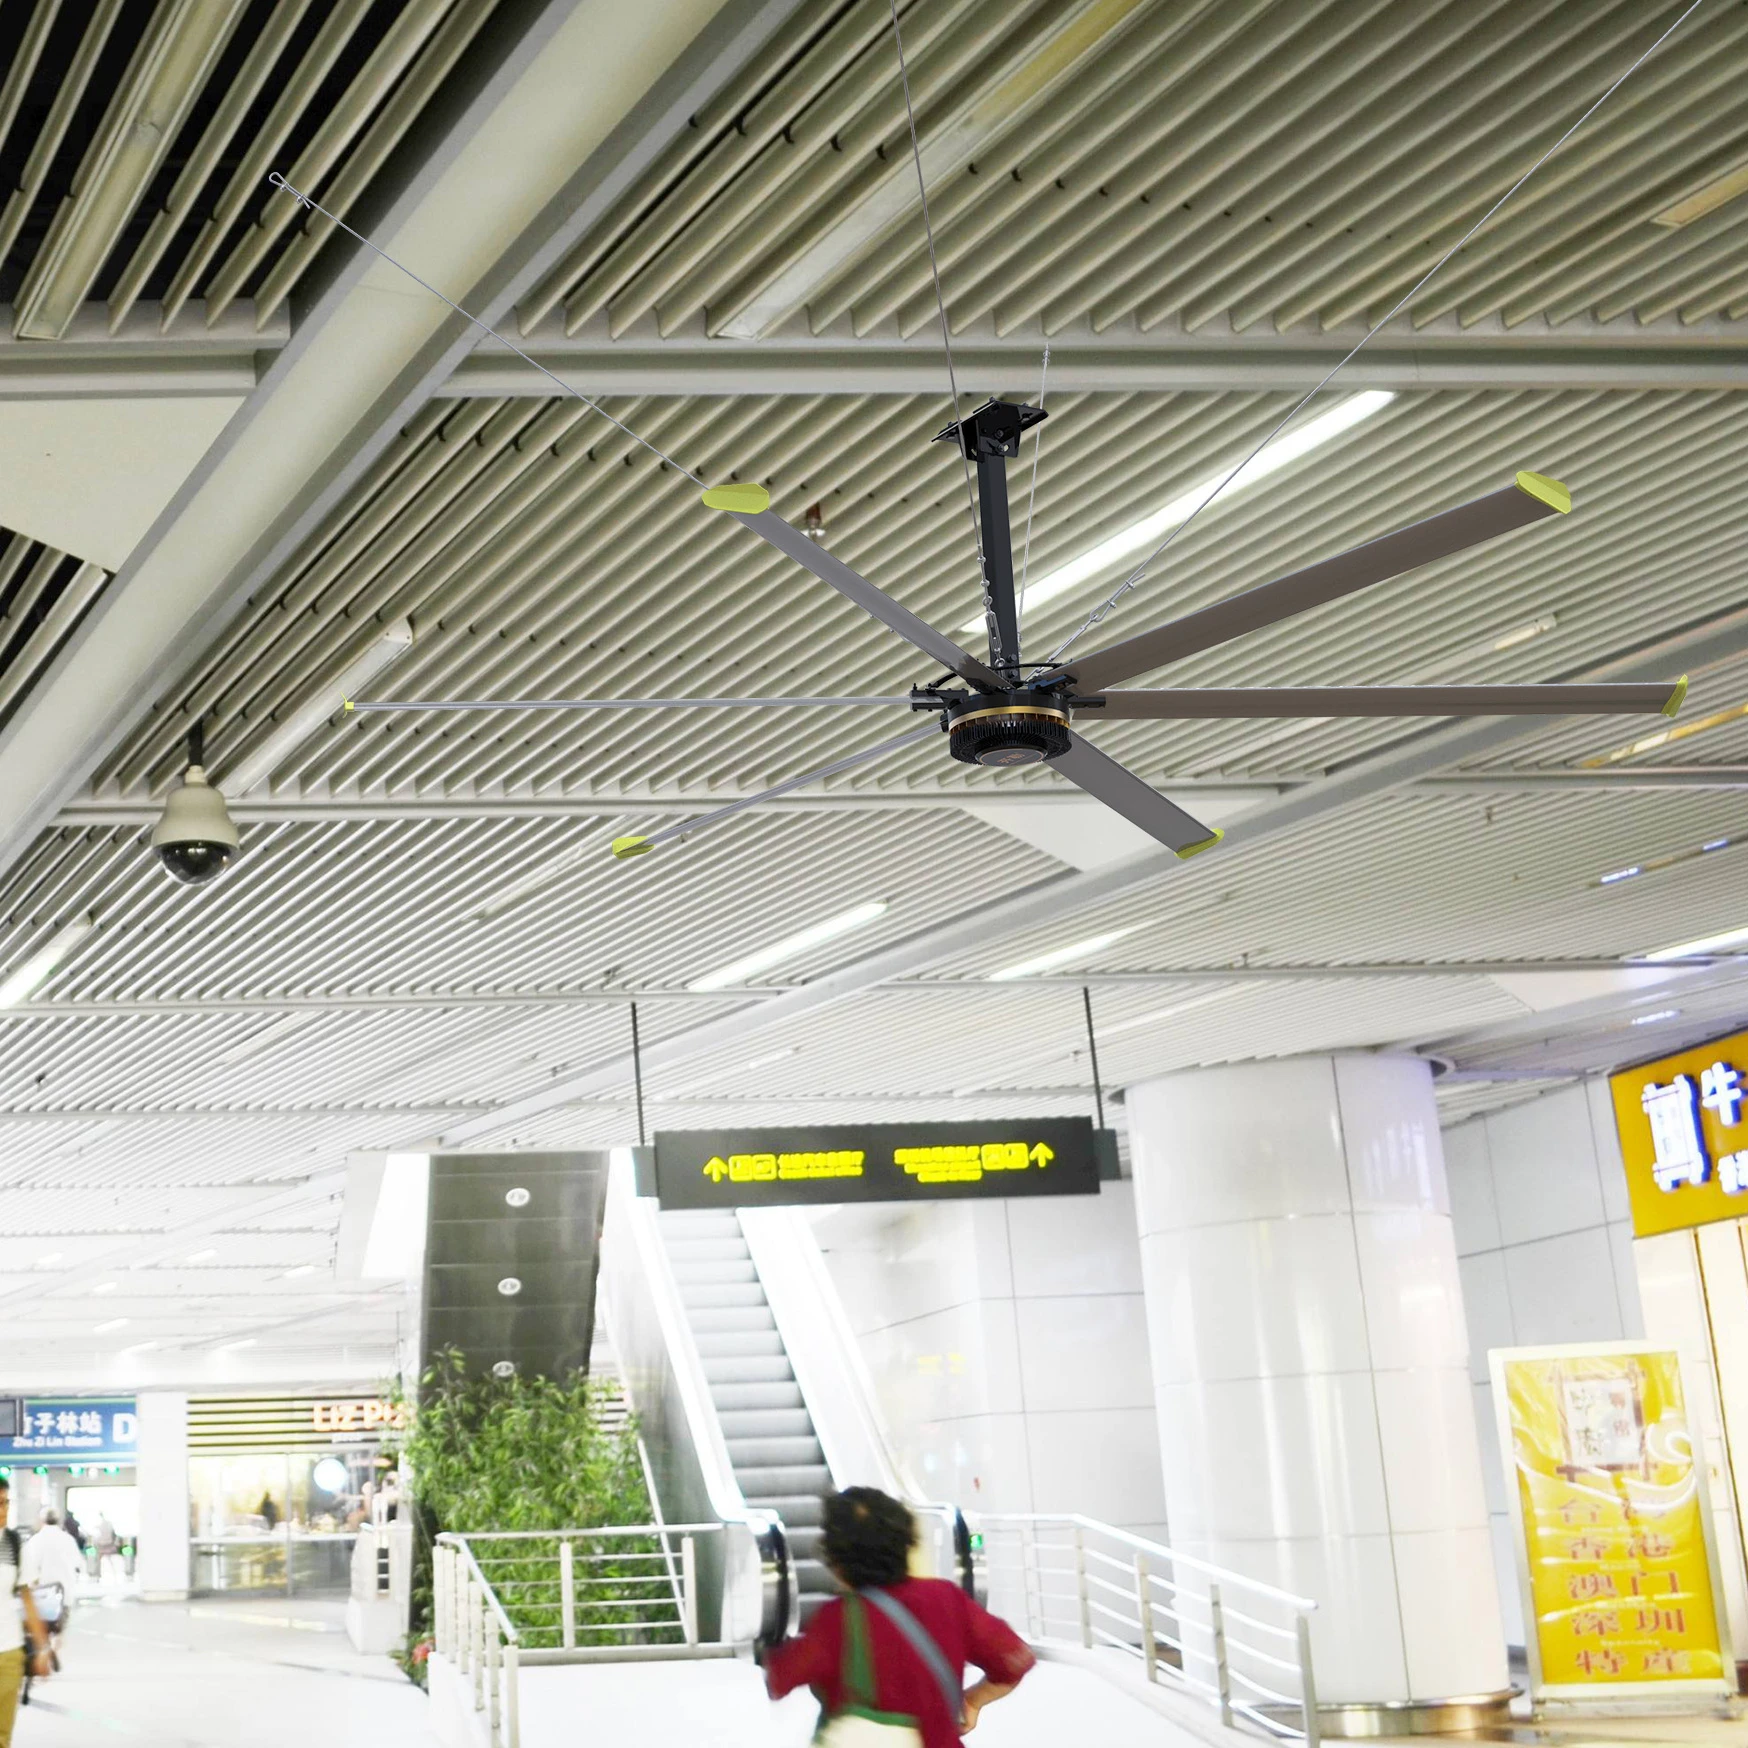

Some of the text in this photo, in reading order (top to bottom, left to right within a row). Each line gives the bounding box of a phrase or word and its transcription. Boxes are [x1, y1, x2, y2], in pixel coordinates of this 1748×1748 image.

[112, 1412, 137, 1443] D
[1569, 1571, 1680, 1599] 澳门
[1571, 1608, 1685, 1636] 深圳
